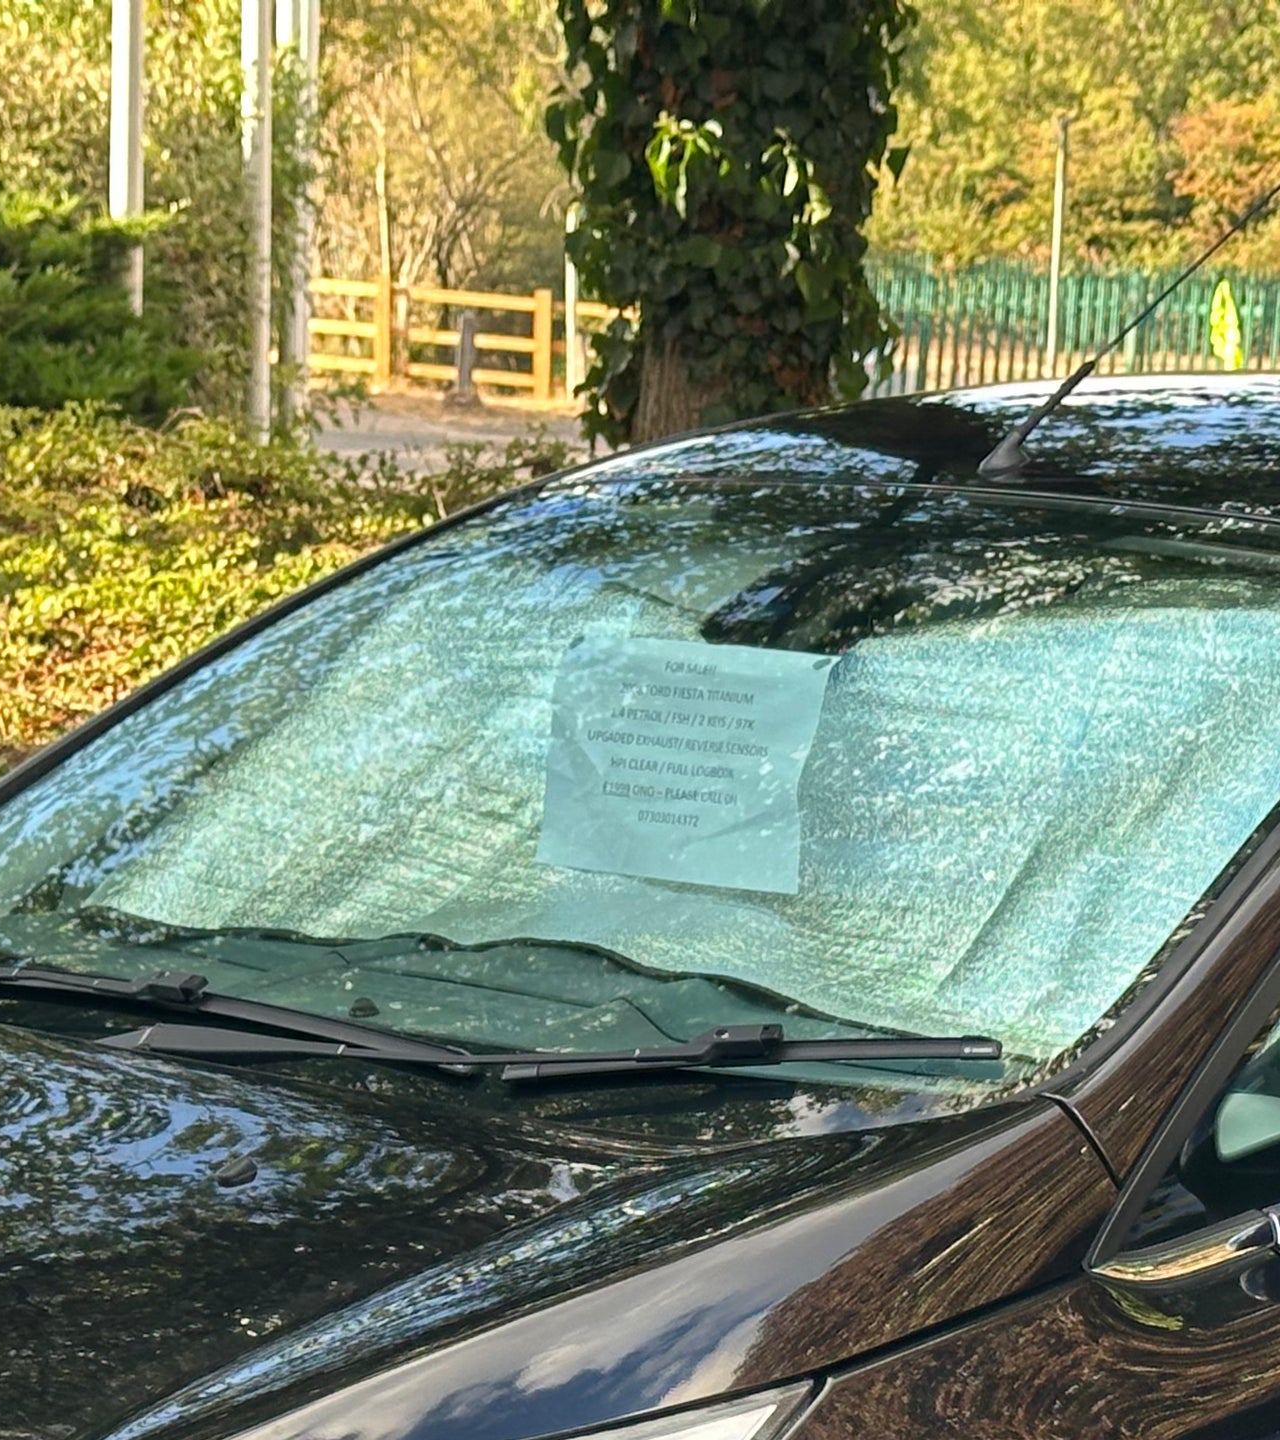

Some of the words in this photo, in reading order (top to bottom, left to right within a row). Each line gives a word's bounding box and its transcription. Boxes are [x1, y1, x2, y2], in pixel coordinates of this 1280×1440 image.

[664, 660, 685, 673] FOR
[672, 686, 705, 701] FIESTA
[707, 689, 755, 705] TITANIUM
[626, 707, 662, 723] PETROL
[671, 711, 690, 725] FSH
[698, 714, 706, 727] 2
[725, 742, 769, 758] SENSORS
[628, 758, 659, 773] CLEAR
[666, 763, 688, 777] FULL
[691, 765, 735, 779] LOGBOOK
[631, 784, 655, 797] ONO
[664, 787, 698, 801] PLEASE
